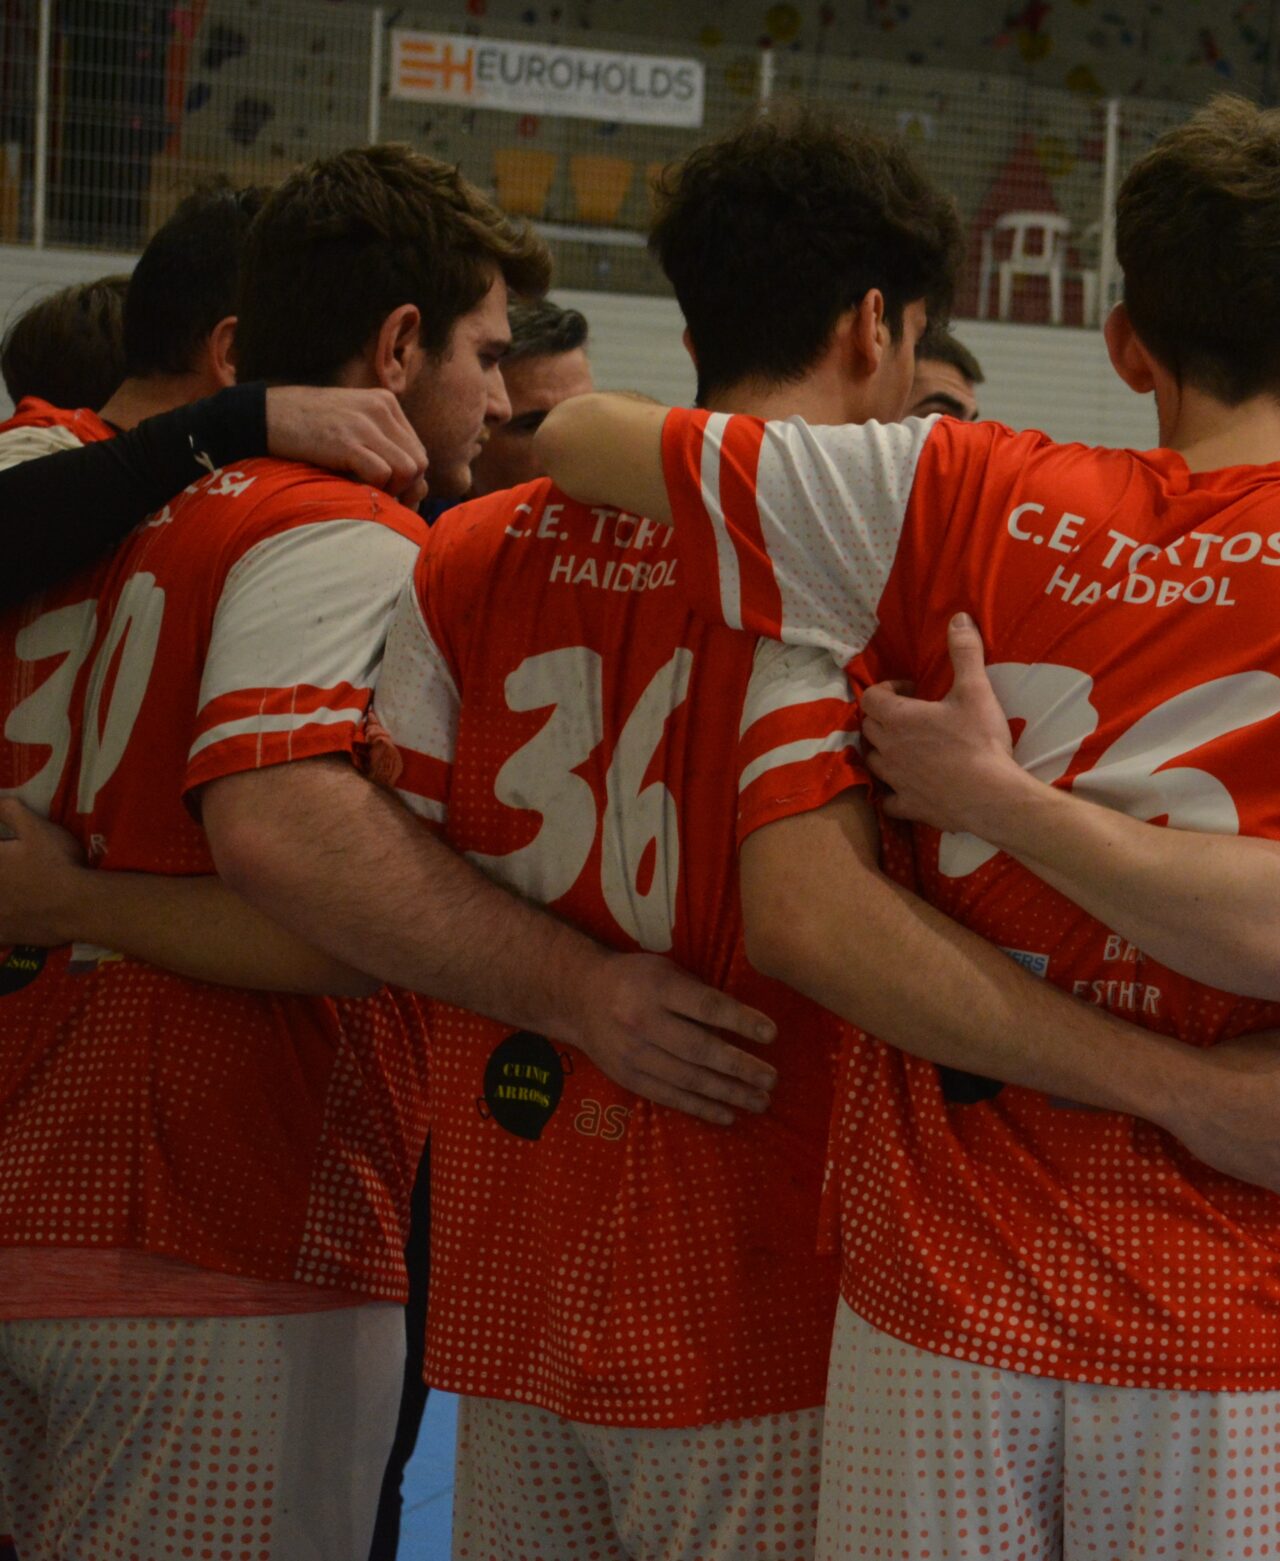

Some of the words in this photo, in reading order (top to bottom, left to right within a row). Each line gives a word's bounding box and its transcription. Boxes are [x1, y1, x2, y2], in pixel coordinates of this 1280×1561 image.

[476, 46, 696, 101] EUROHOLDS
[505, 503, 568, 541] C.E.
[1007, 502, 1085, 554] C.E.
[1045, 565, 1236, 608] HADBOL
[0, 571, 165, 814] 30
[465, 646, 694, 953] 36
